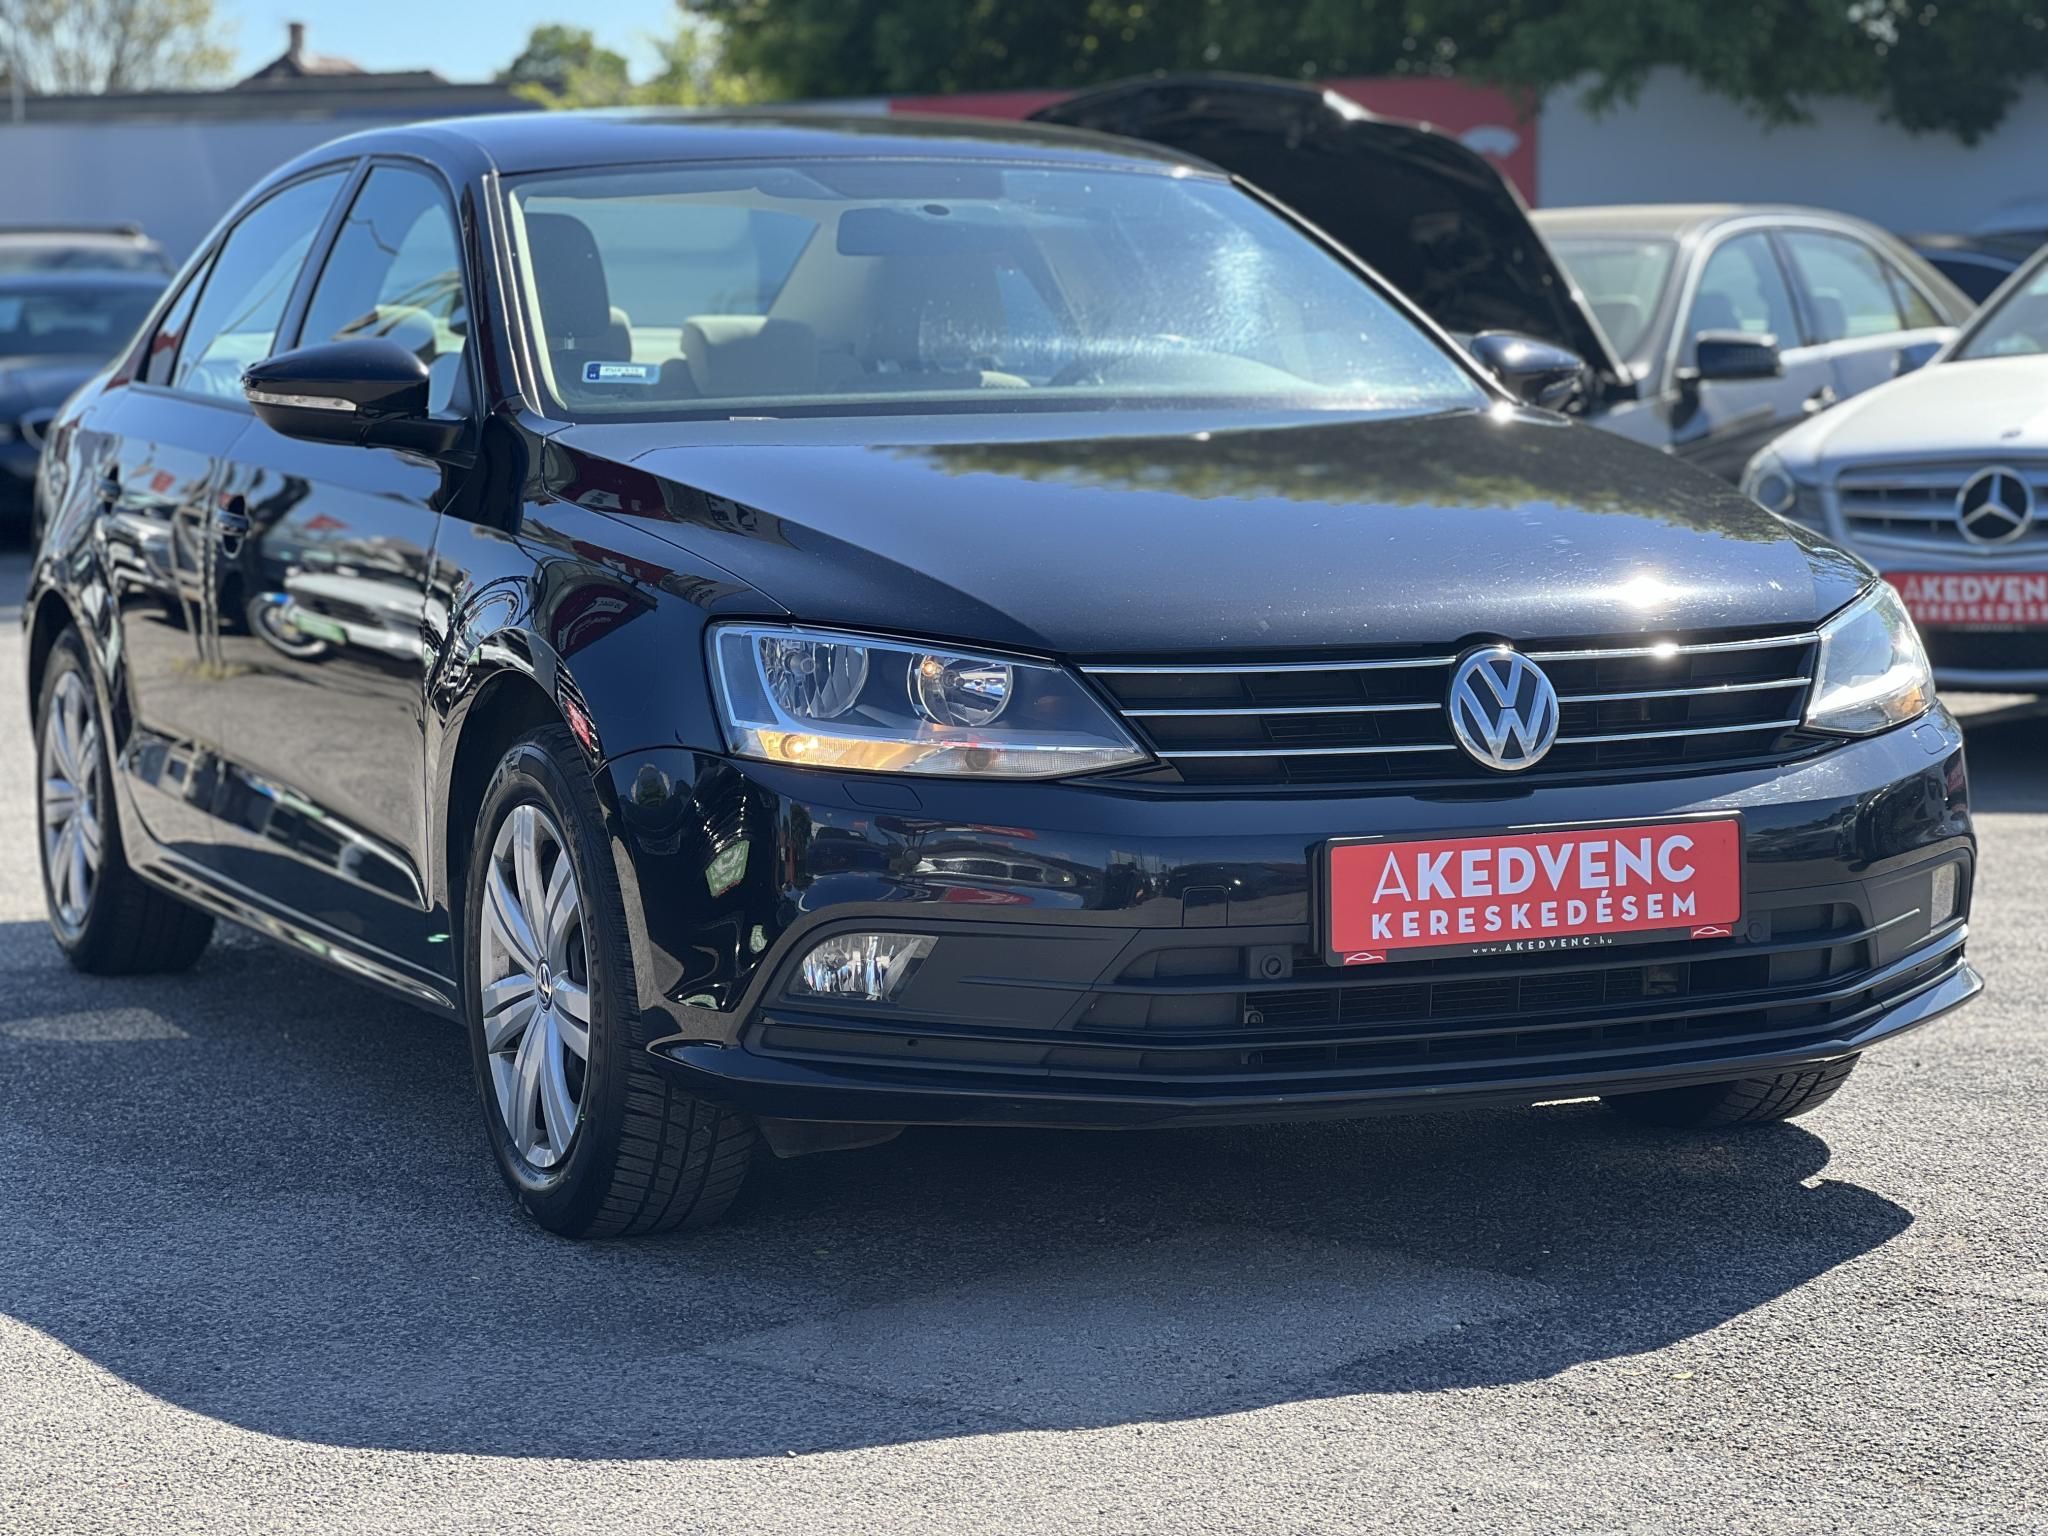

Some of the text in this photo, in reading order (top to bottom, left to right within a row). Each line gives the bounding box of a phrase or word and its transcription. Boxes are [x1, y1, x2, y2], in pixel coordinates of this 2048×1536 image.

[1903, 575, 2047, 601] AKEDVEN
[1908, 601, 2048, 621] ERESKEDÉSE
[1450, 645, 1560, 771] VW
[1371, 835, 1696, 904] AKEDVENC
[1371, 889, 1697, 940] KERESKEDÉSEM
[1472, 936, 1613, 954] www.AKEDVENC.hu
[587, 914, 602, 1048] POLARIS
